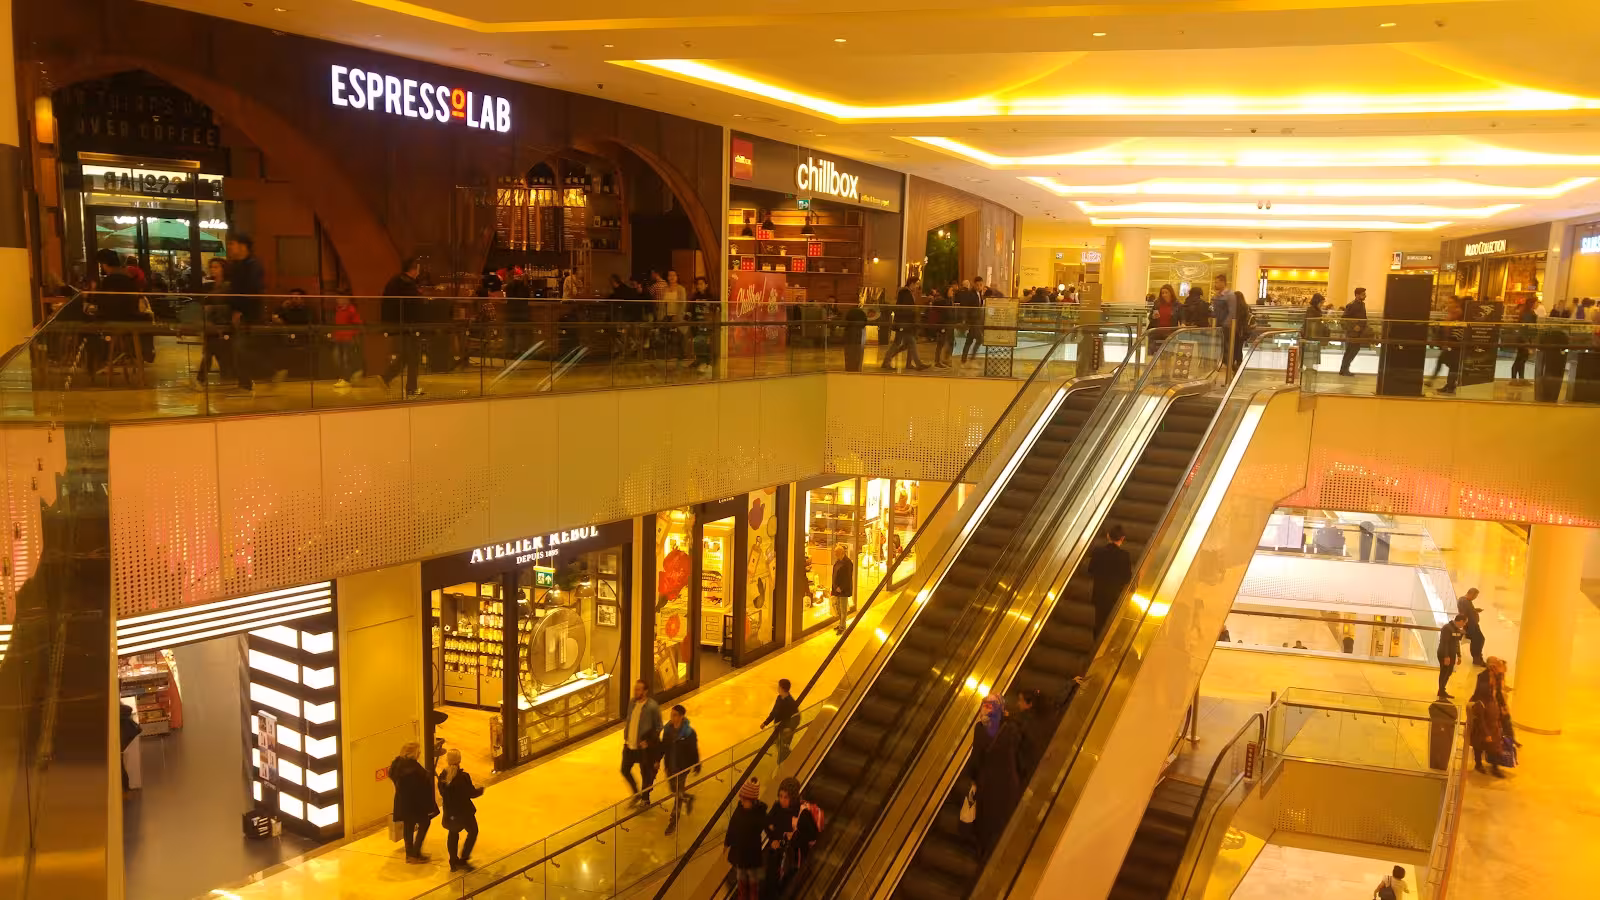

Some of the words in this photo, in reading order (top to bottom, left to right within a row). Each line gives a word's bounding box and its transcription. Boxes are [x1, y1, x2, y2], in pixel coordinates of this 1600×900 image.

[332, 64, 511, 133] ESPRESSOLAB
[139, 124, 216, 145] COFFEE
[797, 156, 859, 199] chillbox
[470, 536, 544, 564] ATELIER
[516, 551, 544, 565] DEPUIS
